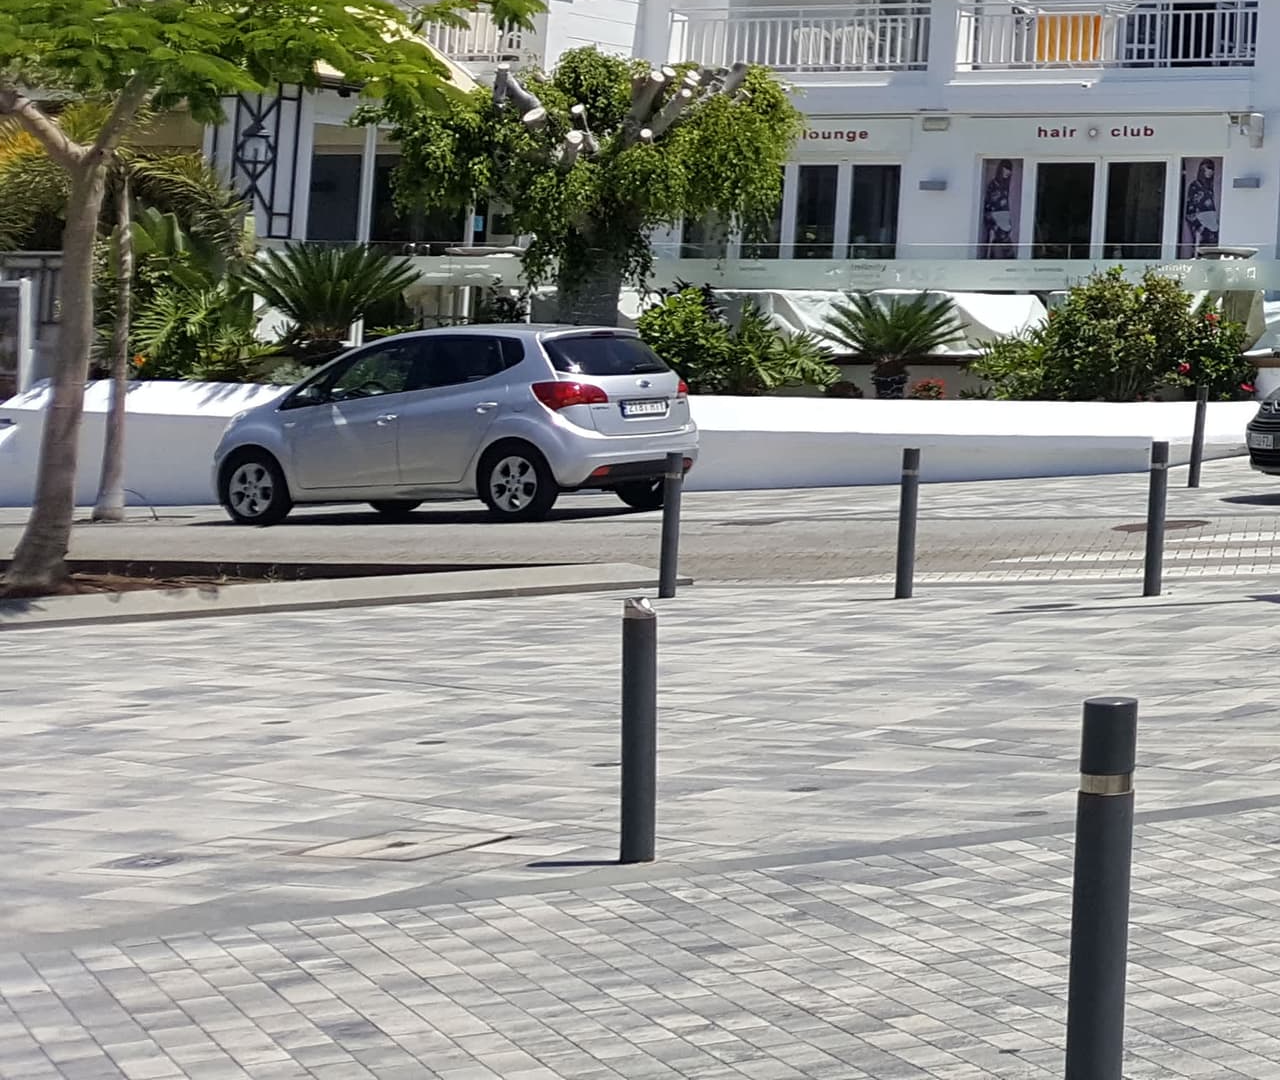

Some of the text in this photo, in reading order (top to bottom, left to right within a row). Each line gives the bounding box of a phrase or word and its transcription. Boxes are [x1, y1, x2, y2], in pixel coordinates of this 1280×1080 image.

[803, 130, 869, 142] lounge
[1037, 125, 1154, 138] hair club
